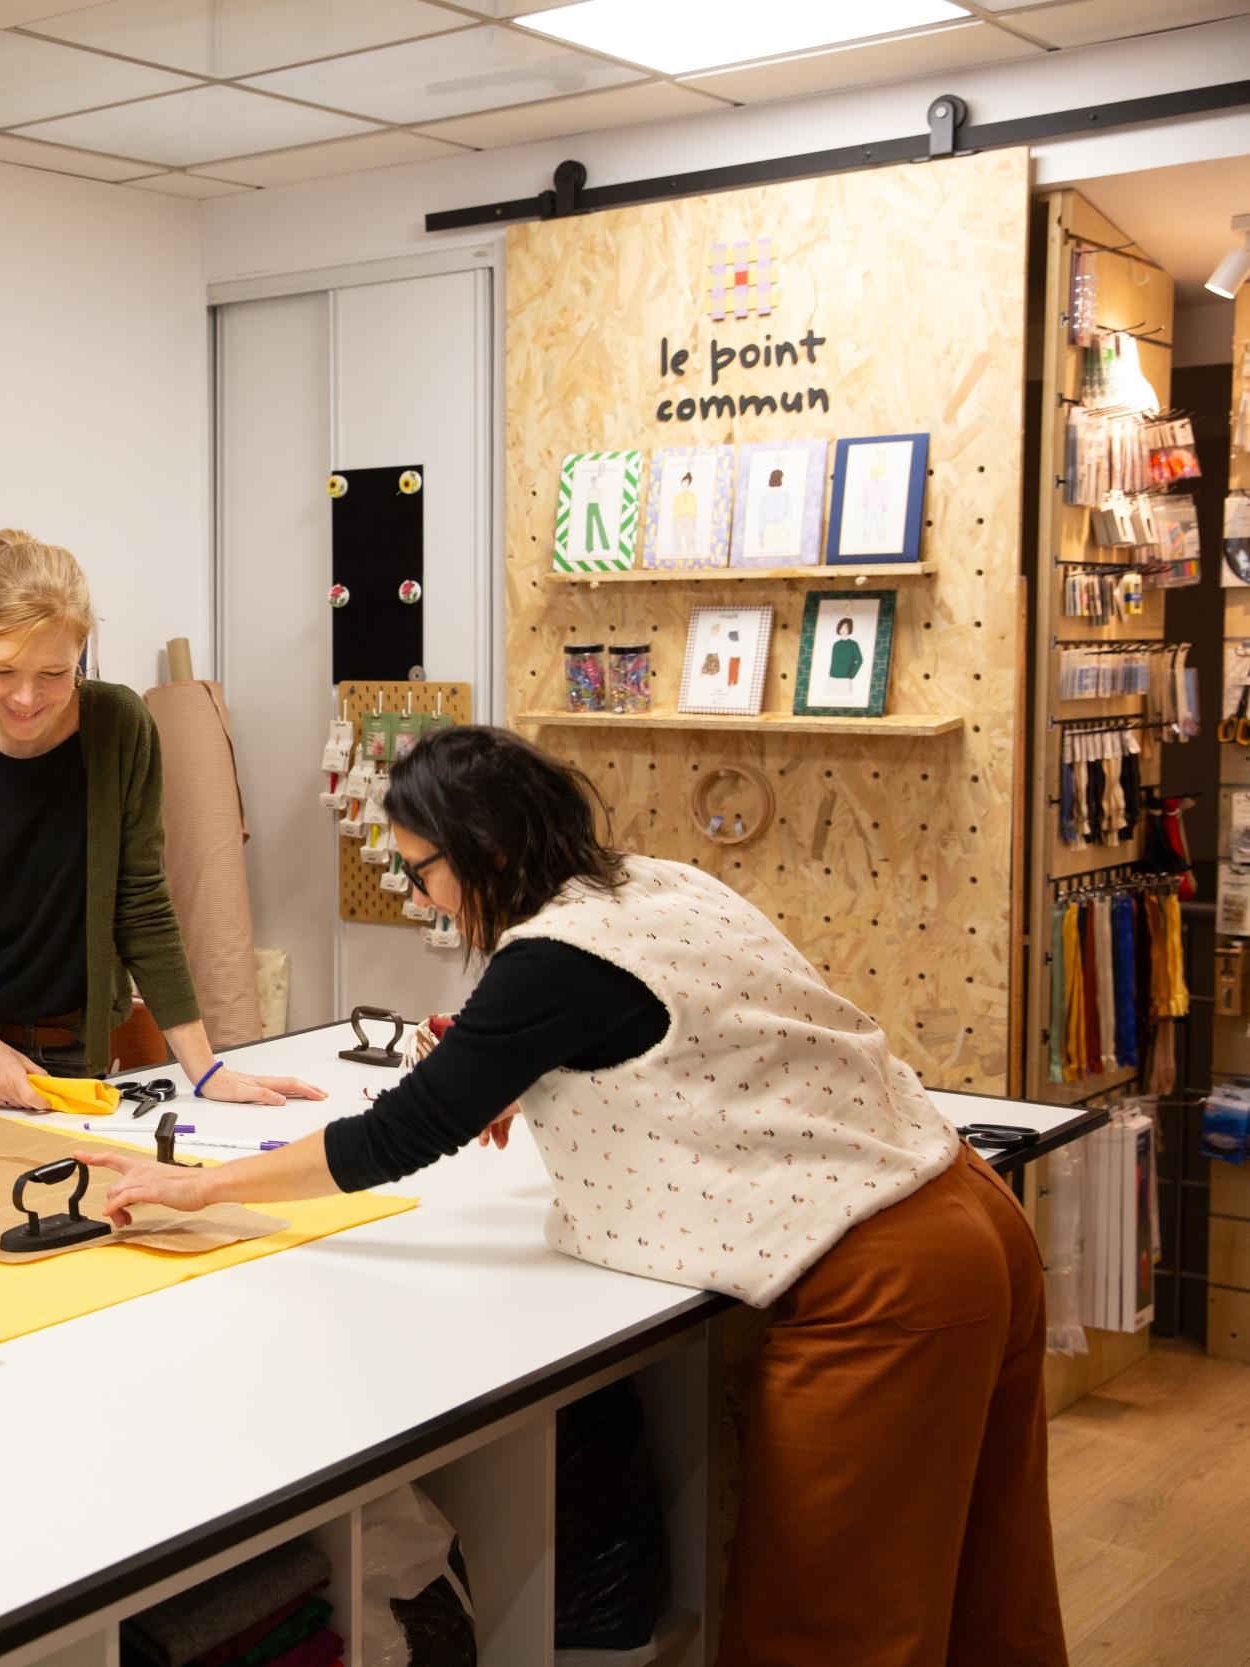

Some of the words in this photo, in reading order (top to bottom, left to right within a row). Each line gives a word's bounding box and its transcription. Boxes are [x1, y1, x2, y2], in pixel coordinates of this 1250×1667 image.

[661, 337, 689, 377] le
[710, 329, 826, 386] point
[657, 387, 829, 422] commun
